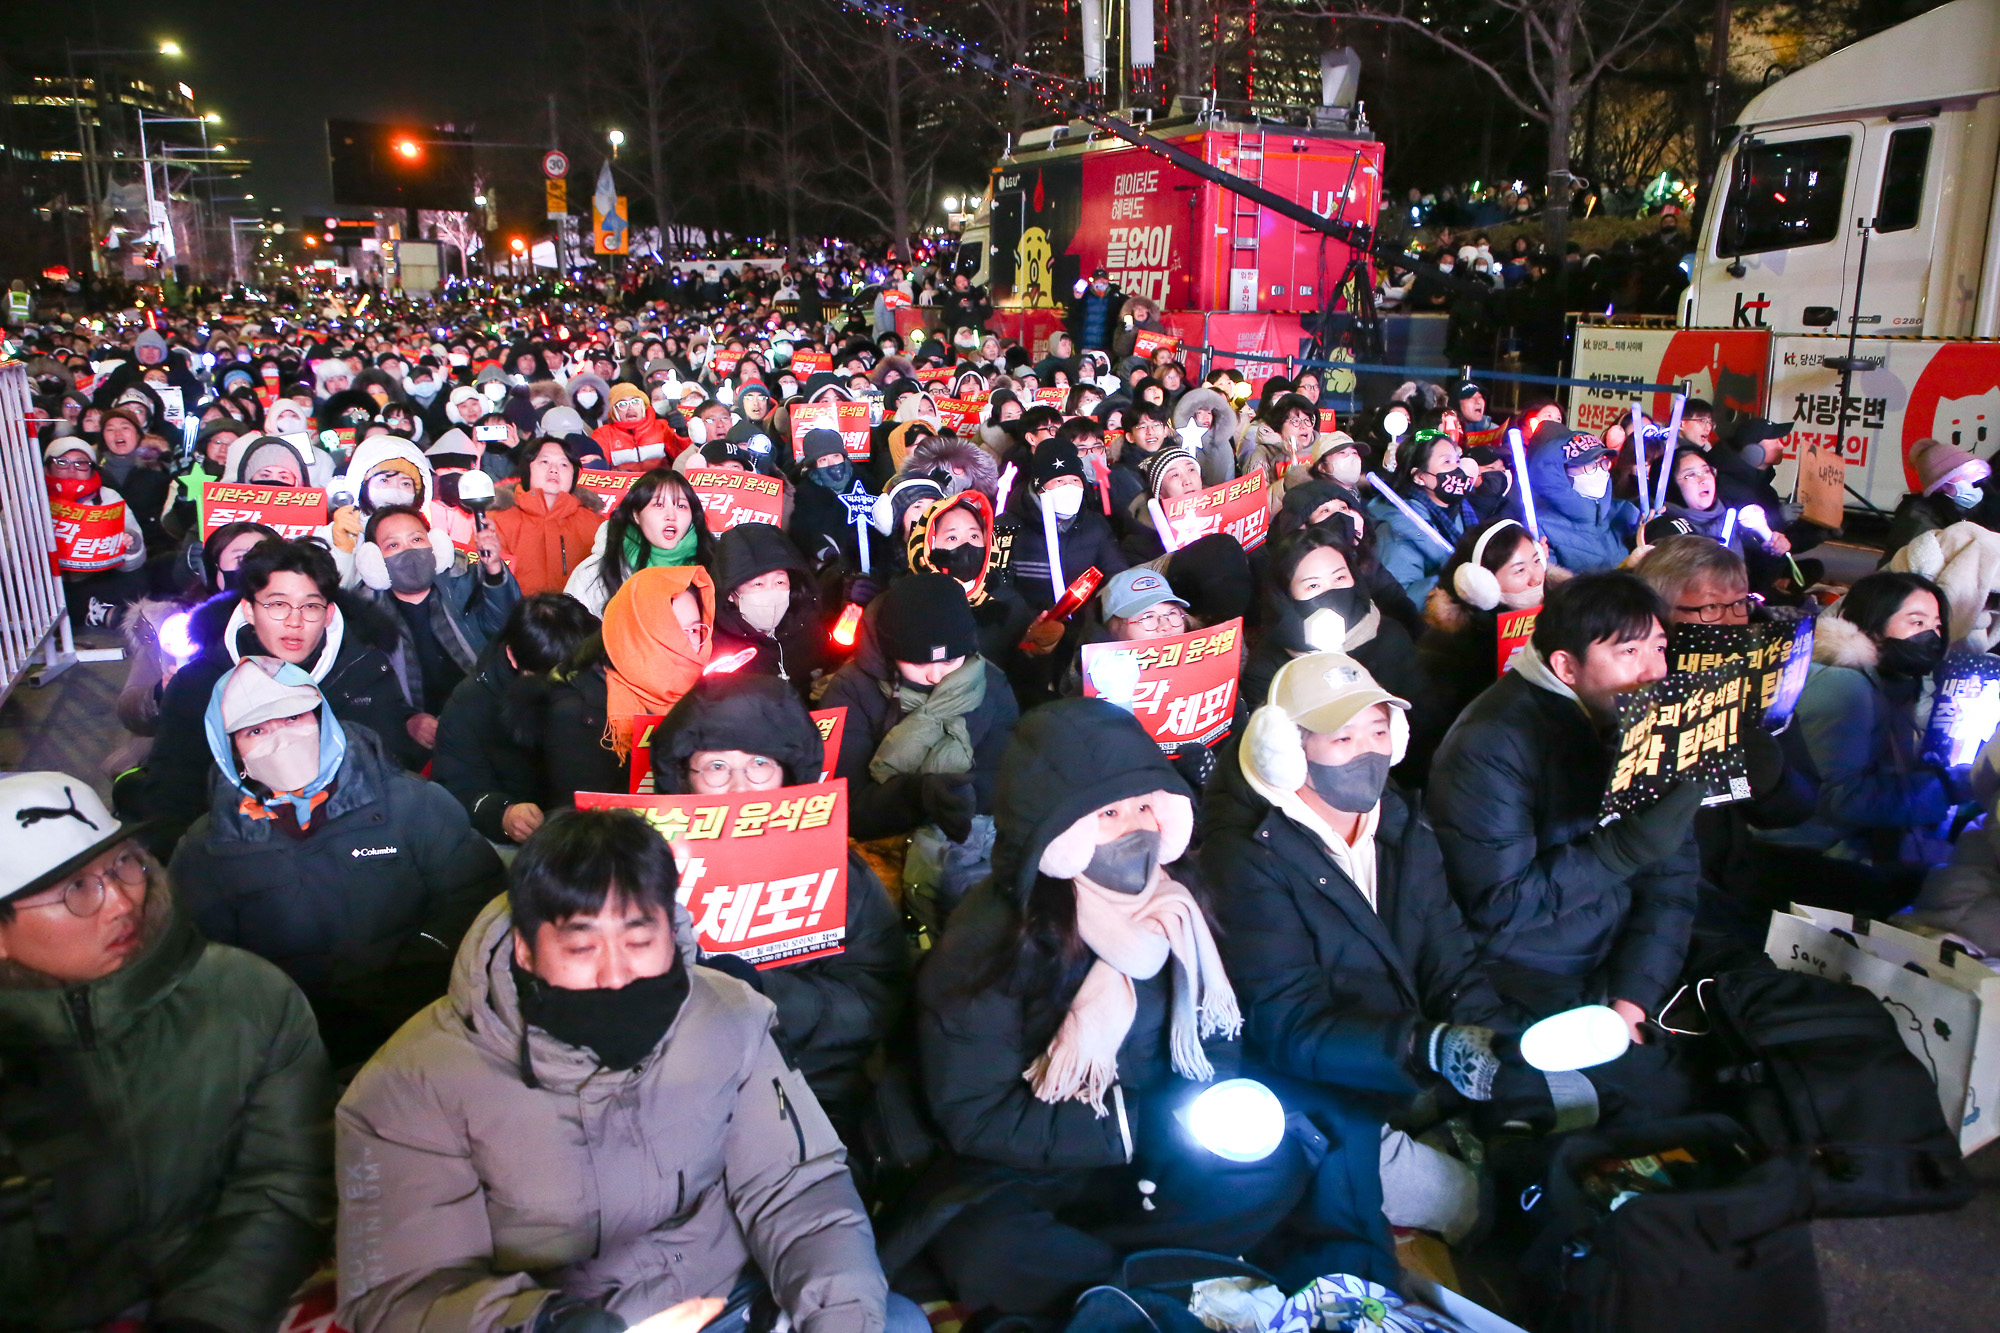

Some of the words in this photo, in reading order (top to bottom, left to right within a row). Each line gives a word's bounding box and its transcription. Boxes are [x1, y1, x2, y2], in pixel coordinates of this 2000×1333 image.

[549, 159, 564, 170] 30
[1114, 170, 1159, 196] 데이터도
[1112, 197, 1145, 220] 혜택도
[1106, 225, 1172, 268] 끝없이
[1732, 292, 1771, 327] kt
[1800, 354, 1825, 366] 당신과
[838, 405, 866, 417] 윤석열
[1577, 403, 1632, 429] 안전주
[1793, 393, 1887, 429] 차량주변
[206, 487, 273, 505] 내란수괴
[273, 491, 323, 506] 윤석열
[688, 473, 743, 489] 내란수괴
[744, 477, 780, 496] 윤석열
[1168, 488, 1226, 518] 내란수괴
[1228, 474, 1262, 502] 윤석열
[1441, 474, 1474, 495] 강남
[86, 504, 124, 522] 윤석열
[1223, 506, 1267, 545] 체포!
[70, 531, 124, 559] 탄핵!
[1184, 626, 1238, 664] 윤석열
[1155, 677, 1236, 736] 체포!
[1620, 702, 1682, 752] 내란수괴
[1700, 676, 1741, 718] 윤석열
[1611, 734, 1666, 793] 즉각
[1676, 706, 1739, 772] 탄핵!
[731, 792, 838, 838] 윤석열
[360, 846, 398, 857] Columbia
[692, 868, 839, 943] 체포!
[1791, 944, 1827, 975] Save
